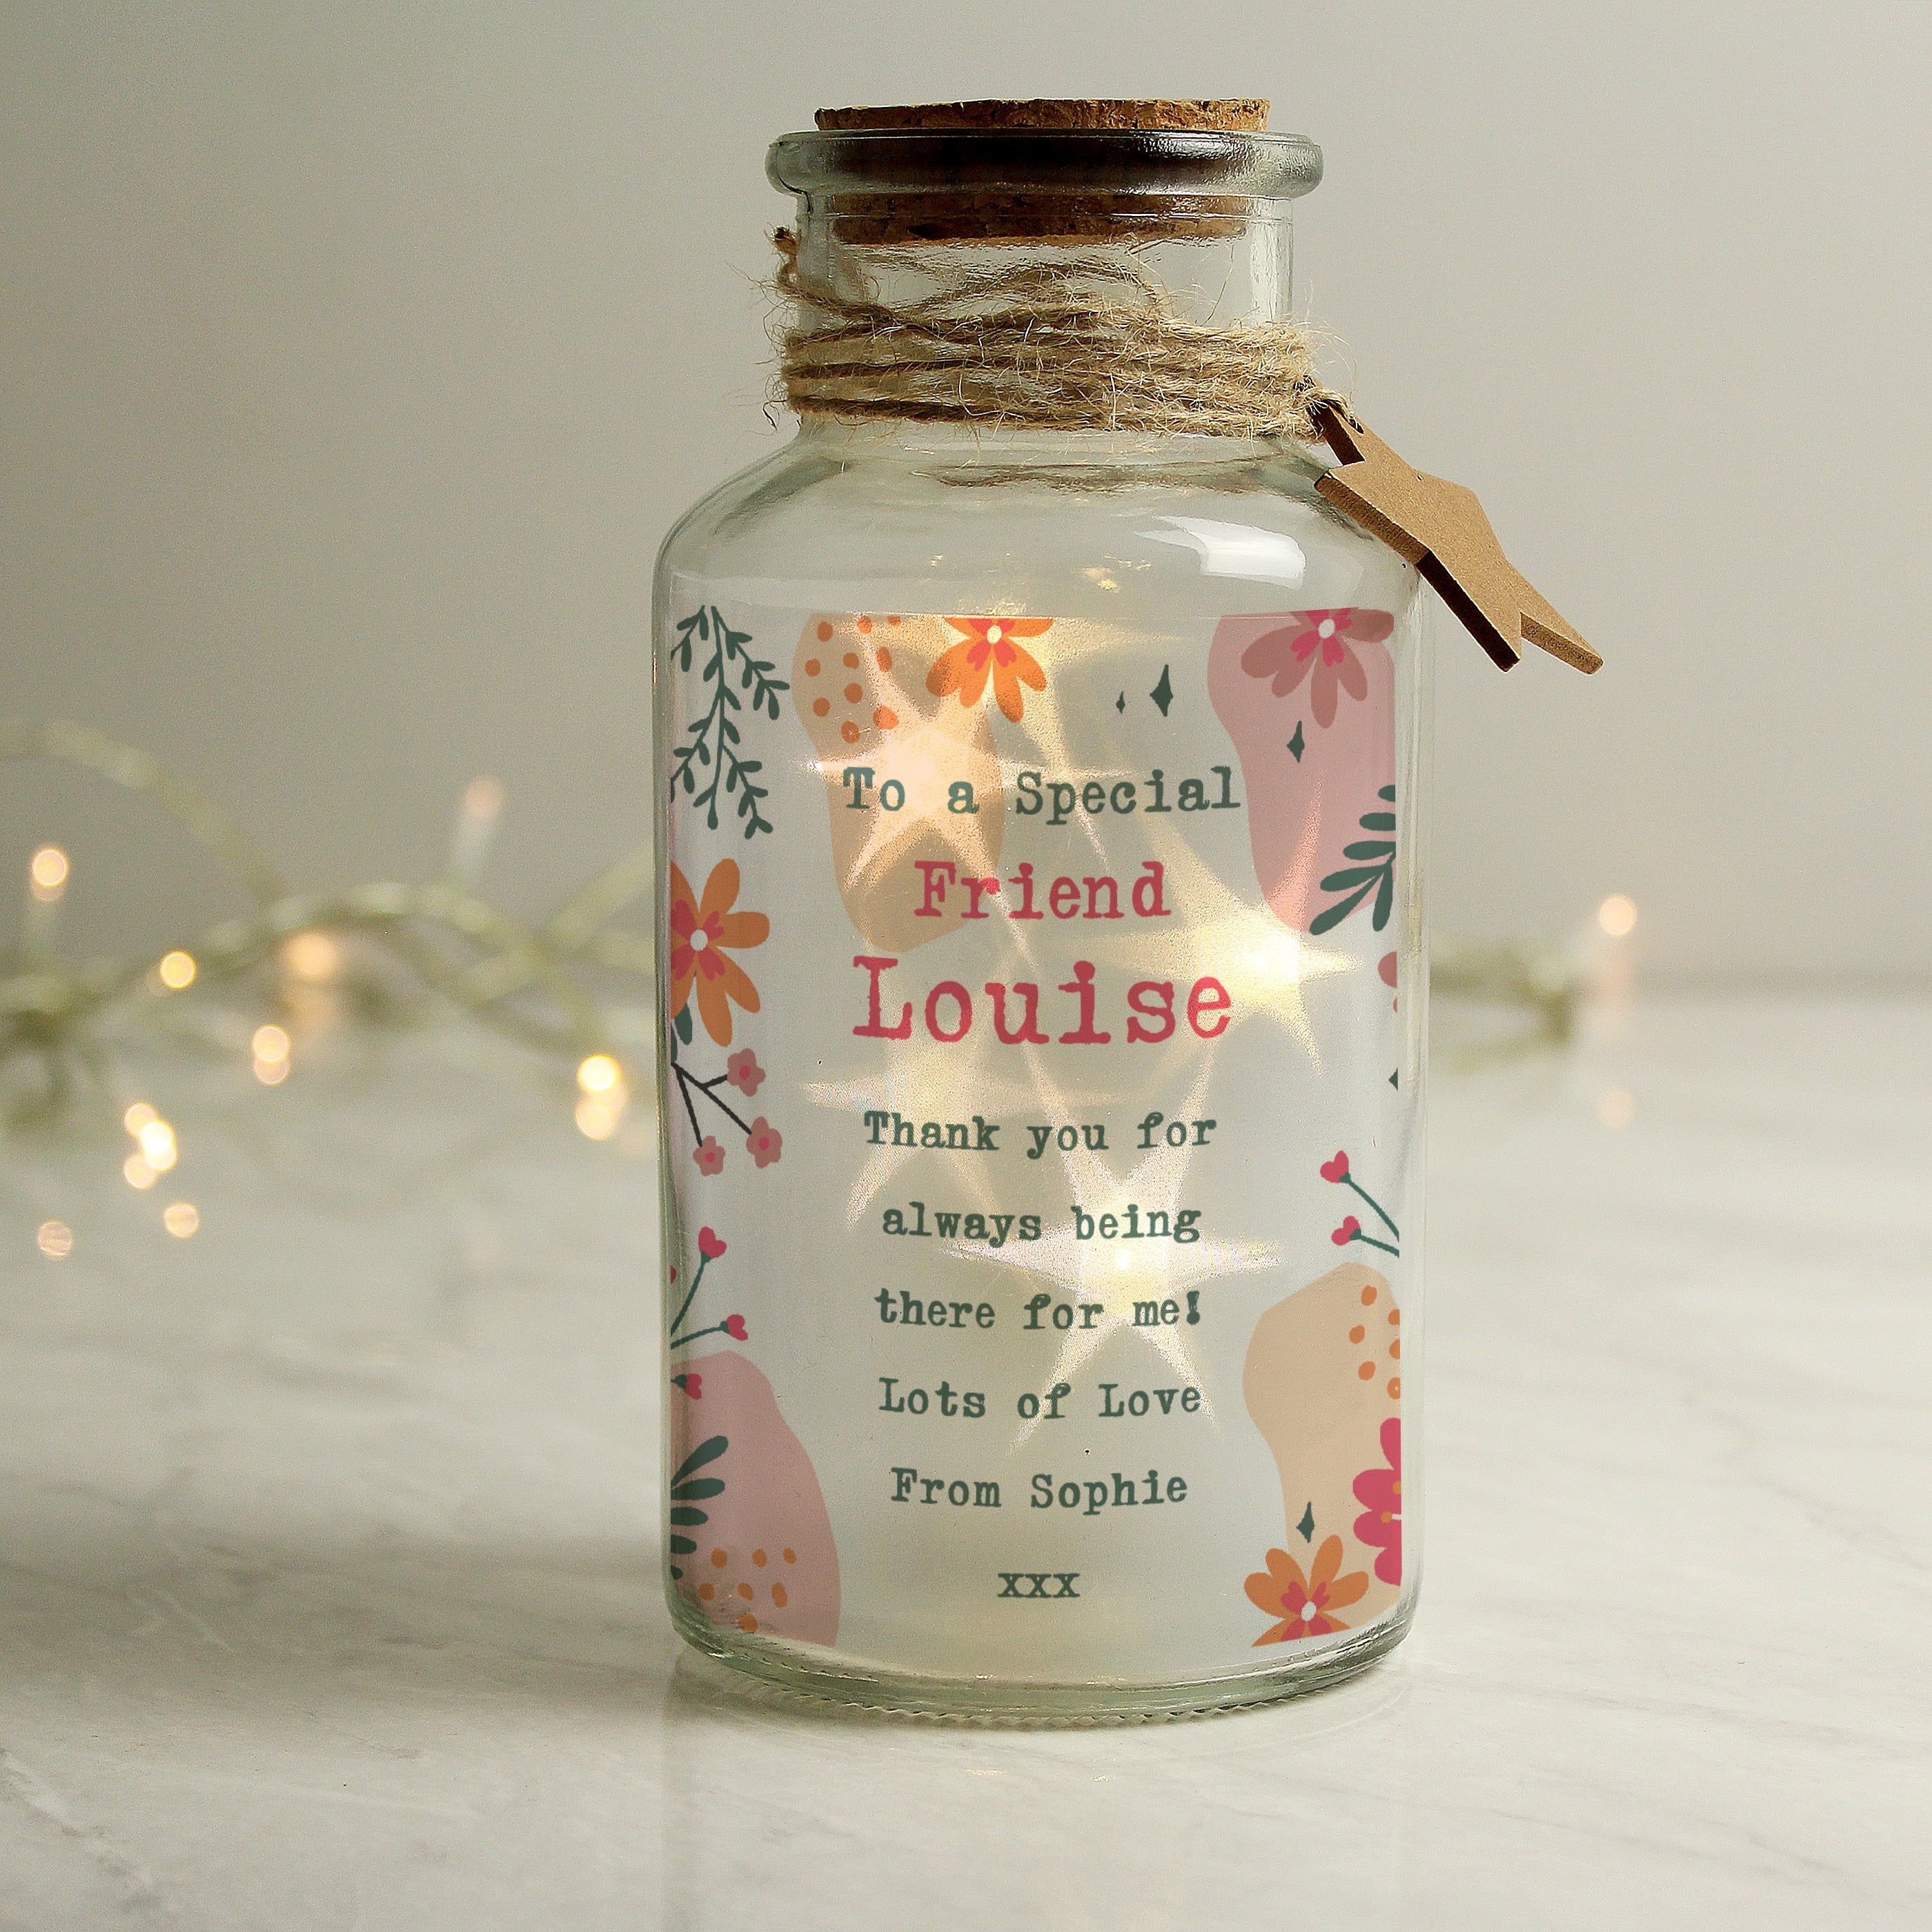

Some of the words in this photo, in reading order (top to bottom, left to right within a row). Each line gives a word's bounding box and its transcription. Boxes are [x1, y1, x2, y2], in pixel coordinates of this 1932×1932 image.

[842, 766, 906, 811] To
[947, 780, 979, 814] a
[1015, 765, 1241, 826] Special
[914, 860, 1172, 920] Friend
[852, 955, 1233, 1045] Louise
[863, 1110, 1000, 1152] Thank
[1026, 1121, 1110, 1161] you
[1136, 1111, 1217, 1150] for
[882, 1201, 1043, 1249] always
[1070, 1204, 1202, 1244] being
[874, 1288, 996, 1329] there
[1023, 1293, 1105, 1330] for
[1131, 1289, 1201, 1328] me!
[878, 1377, 986, 1419] Lots
[1016, 1381, 1072, 1420] of
[1098, 1383, 1201, 1418] Love
[890, 1467, 1002, 1508] From
[1030, 1469, 1187, 1517] Sophie
[997, 1573, 1081, 1599] xxx
